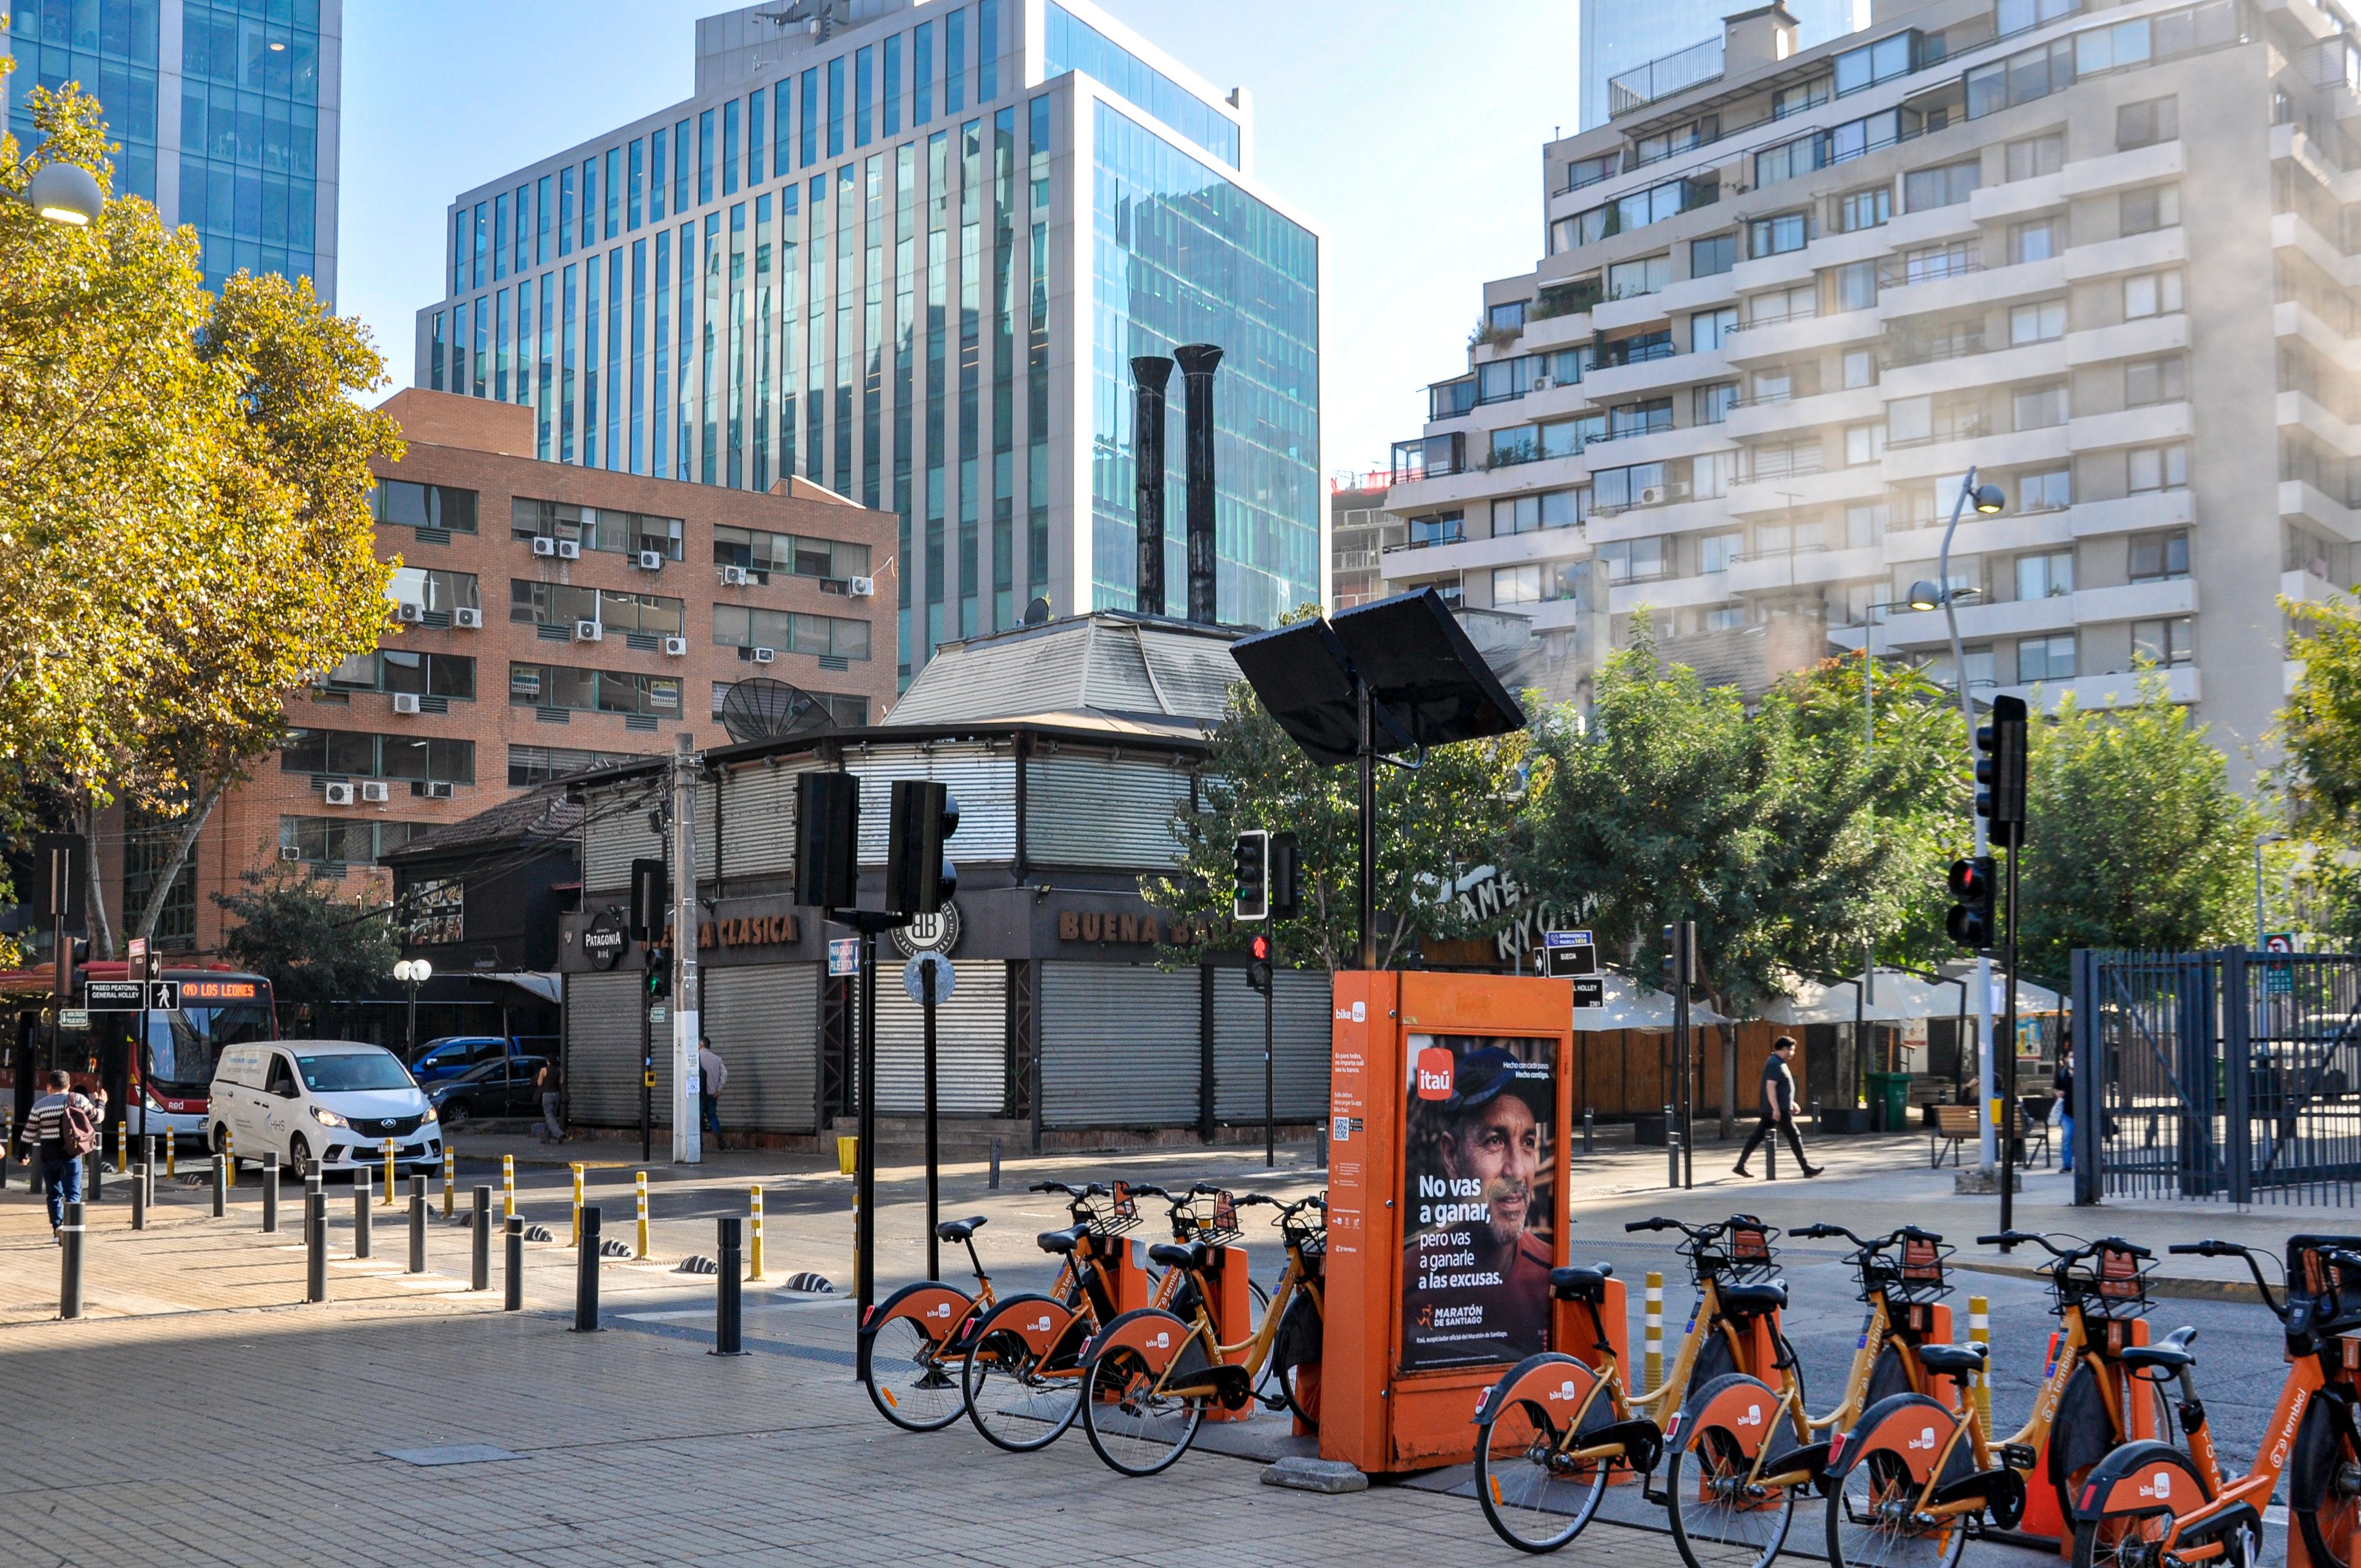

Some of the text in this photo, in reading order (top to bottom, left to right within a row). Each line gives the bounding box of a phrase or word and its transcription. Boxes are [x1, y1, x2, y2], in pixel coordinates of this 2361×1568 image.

[718, 915, 796, 945] CLASICA
[1059, 912, 1160, 943] BUENA
[586, 931, 621, 947] PATAGONIA
[830, 944, 854, 955] PARA CRUZAR
[830, 960, 841, 971] PULSE
[201, 984, 218, 997] LOS
[221, 984, 256, 997] LEONES
[1335, 1008, 1352, 1020] bike
[1420, 1069, 1450, 1090] itaú
[1515, 1070, 1531, 1078] Hecho
[168, 1100, 184, 1109] Red
[270, 1119, 286, 1132] HHS
[1420, 1175, 1481, 1197] No vas
[1420, 1202, 1491, 1228] a ganar,
[1420, 1232, 1471, 1251] pero vas
[1420, 1249, 1474, 1271] a ganarle
[1418, 1271, 1503, 1289] a las excusas.
[1434, 1304, 1483, 1318] MARATÓN
[1434, 1316, 1482, 1327] DE SANTIAGO
[1426, 1335, 1450, 1343] auspiciador
[2053, 1346, 2075, 1393] tembici
[1549, 1391, 1562, 1400] bike
[2281, 1387, 2307, 1438] tembici
[1908, 1439, 1922, 1449] bike
[2138, 1485, 2154, 1497] bike
